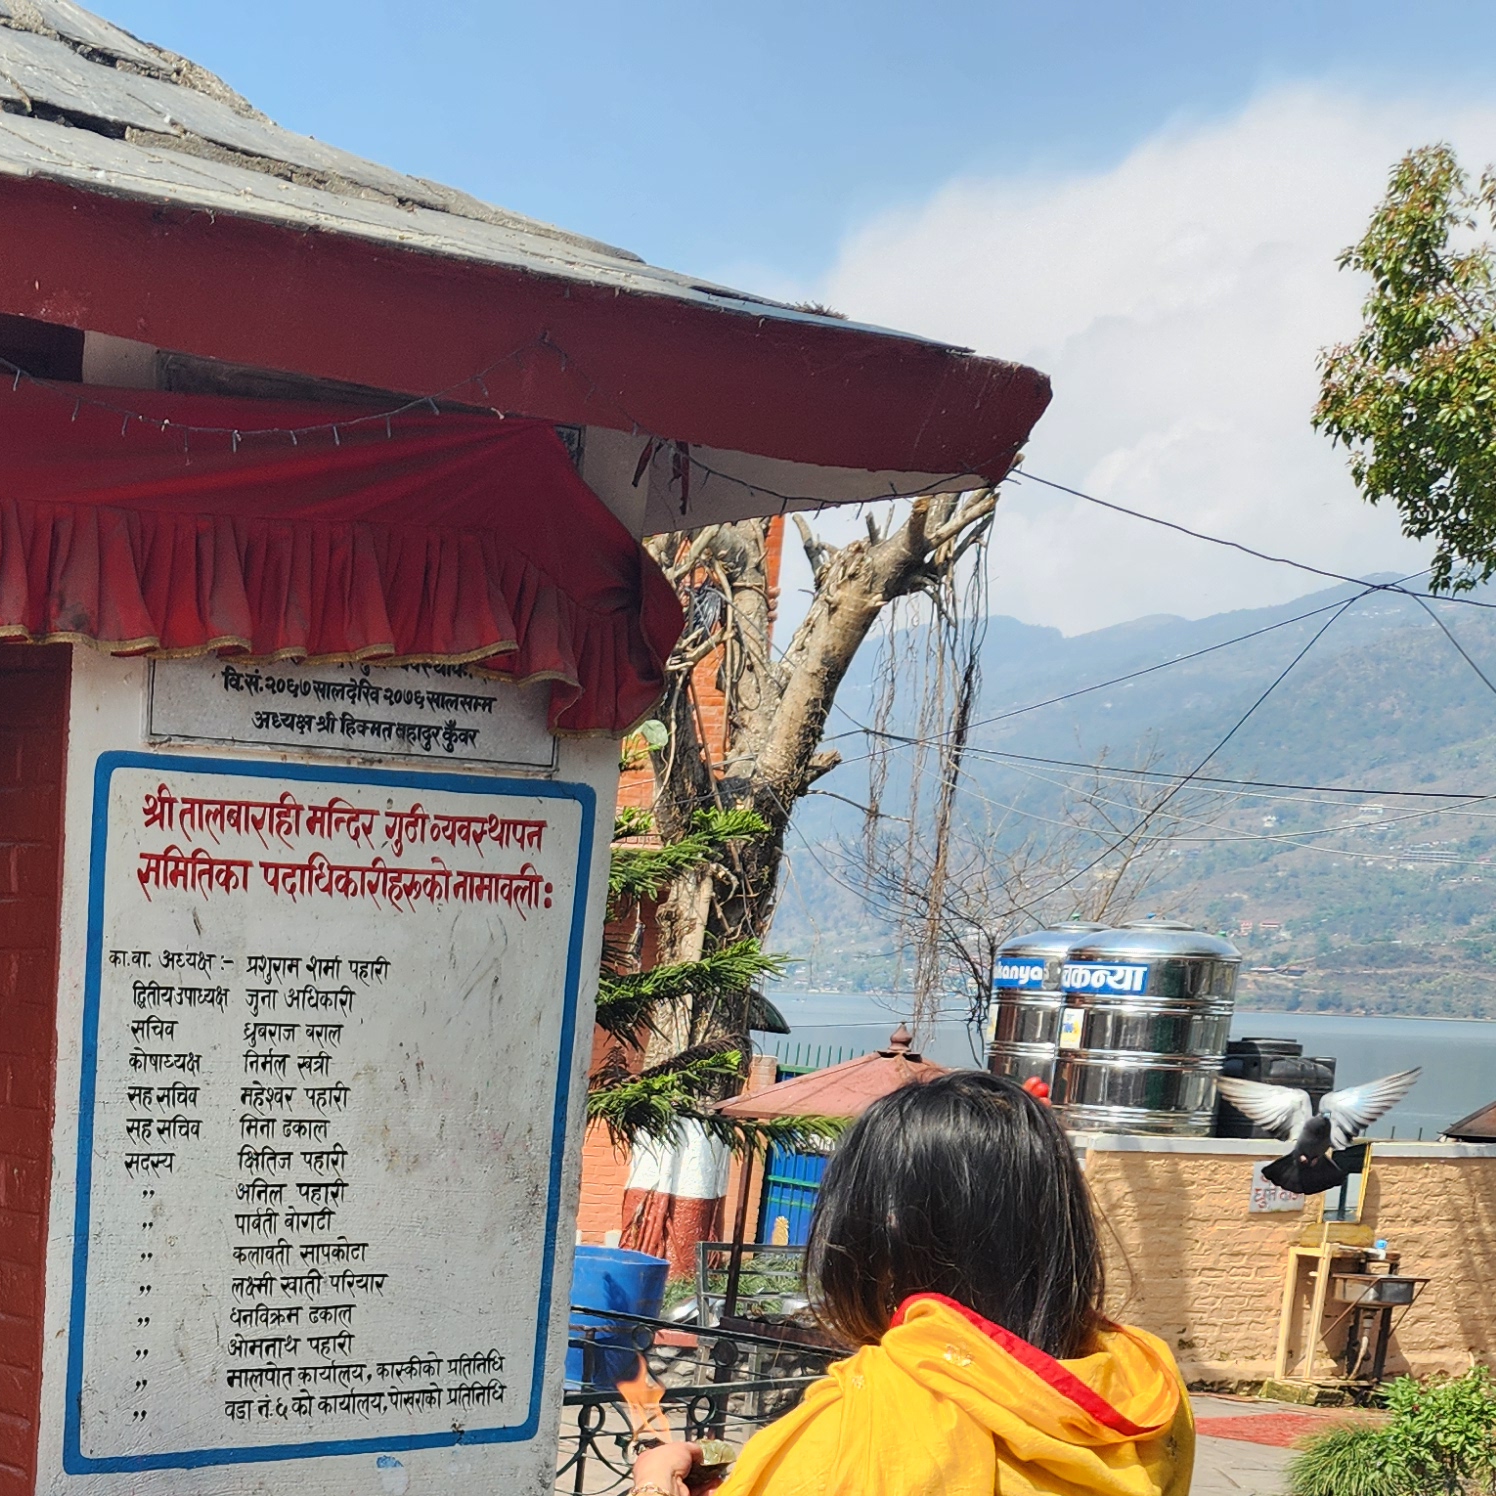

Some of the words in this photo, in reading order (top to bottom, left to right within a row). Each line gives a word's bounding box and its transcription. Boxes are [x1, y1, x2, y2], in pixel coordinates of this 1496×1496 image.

[251, 710, 316, 735] अध्यक्ष
[316, 711, 336, 734] श्री
[142, 784, 176, 830] श्री
[178, 791, 304, 850] तालबाराही
[306, 796, 380, 851] मन्दिर
[384, 803, 429, 857] गुठी
[431, 812, 548, 859] व्यवस्थापन
[137, 844, 254, 902] समितिका
[306, 954, 342, 982] शर्मा
[348, 955, 391, 987] पहारी
[245, 988, 279, 1018] जुना
[284, 984, 356, 1018] अधिकारी
[131, 1015, 179, 1043] सचिव
[305, 1023, 344, 1048] बराल
[242, 1048, 291, 1082] निर्मल
[156, 1081, 201, 1113] सचिव
[240, 1080, 297, 1115] महेश्वर
[303, 1081, 351, 1117] पहारी
[156, 1114, 203, 1145] सचिव
[239, 1113, 277, 1140] मिना
[282, 1118, 331, 1143] ढकाल
[124, 1152, 176, 1179] सदस्य
[237, 1144, 294, 1176] क्षितिज
[300, 1142, 348, 1177] पहारी
[235, 1177, 288, 1206] अनिल
[296, 1178, 349, 1208] पहारी
[299, 1236, 369, 1269] सापकोटा
[231, 1271, 277, 1303] लक्ष्मी
[329, 1268, 389, 1298] परियार
[309, 1304, 356, 1328] ढकाल
[227, 1333, 302, 1359] ओमनाथ
[307, 1330, 355, 1360] पहारी
[226, 1361, 296, 1393] मालपोत
[447, 1348, 505, 1380] प्रतिनिधि
[225, 1400, 254, 1421] वडा
[447, 1378, 507, 1412] प्रतिनिधि
